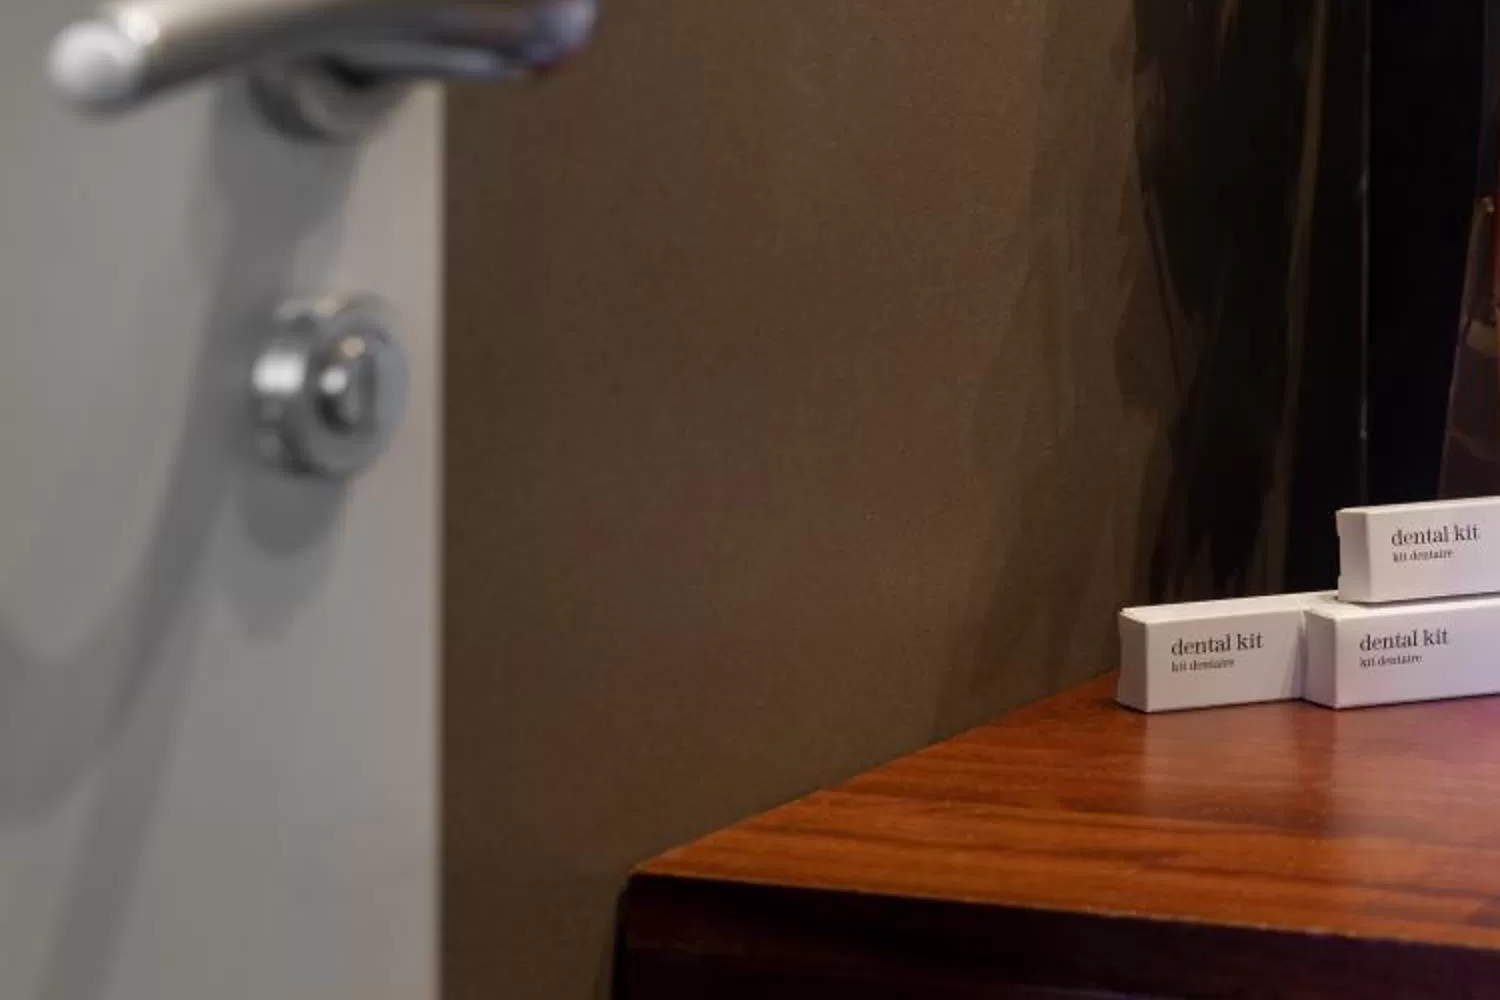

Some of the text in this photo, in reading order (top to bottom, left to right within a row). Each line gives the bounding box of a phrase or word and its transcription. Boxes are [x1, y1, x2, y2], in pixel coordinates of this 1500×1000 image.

[1391, 523, 1480, 547] dental kit
[1393, 549, 1454, 563] kit dentaire
[1171, 631, 1265, 656] dental kit
[1359, 626, 1449, 652] dental kit
[1171, 658, 1235, 673] kit dentaire
[1360, 654, 1423, 668] kit dentaire
